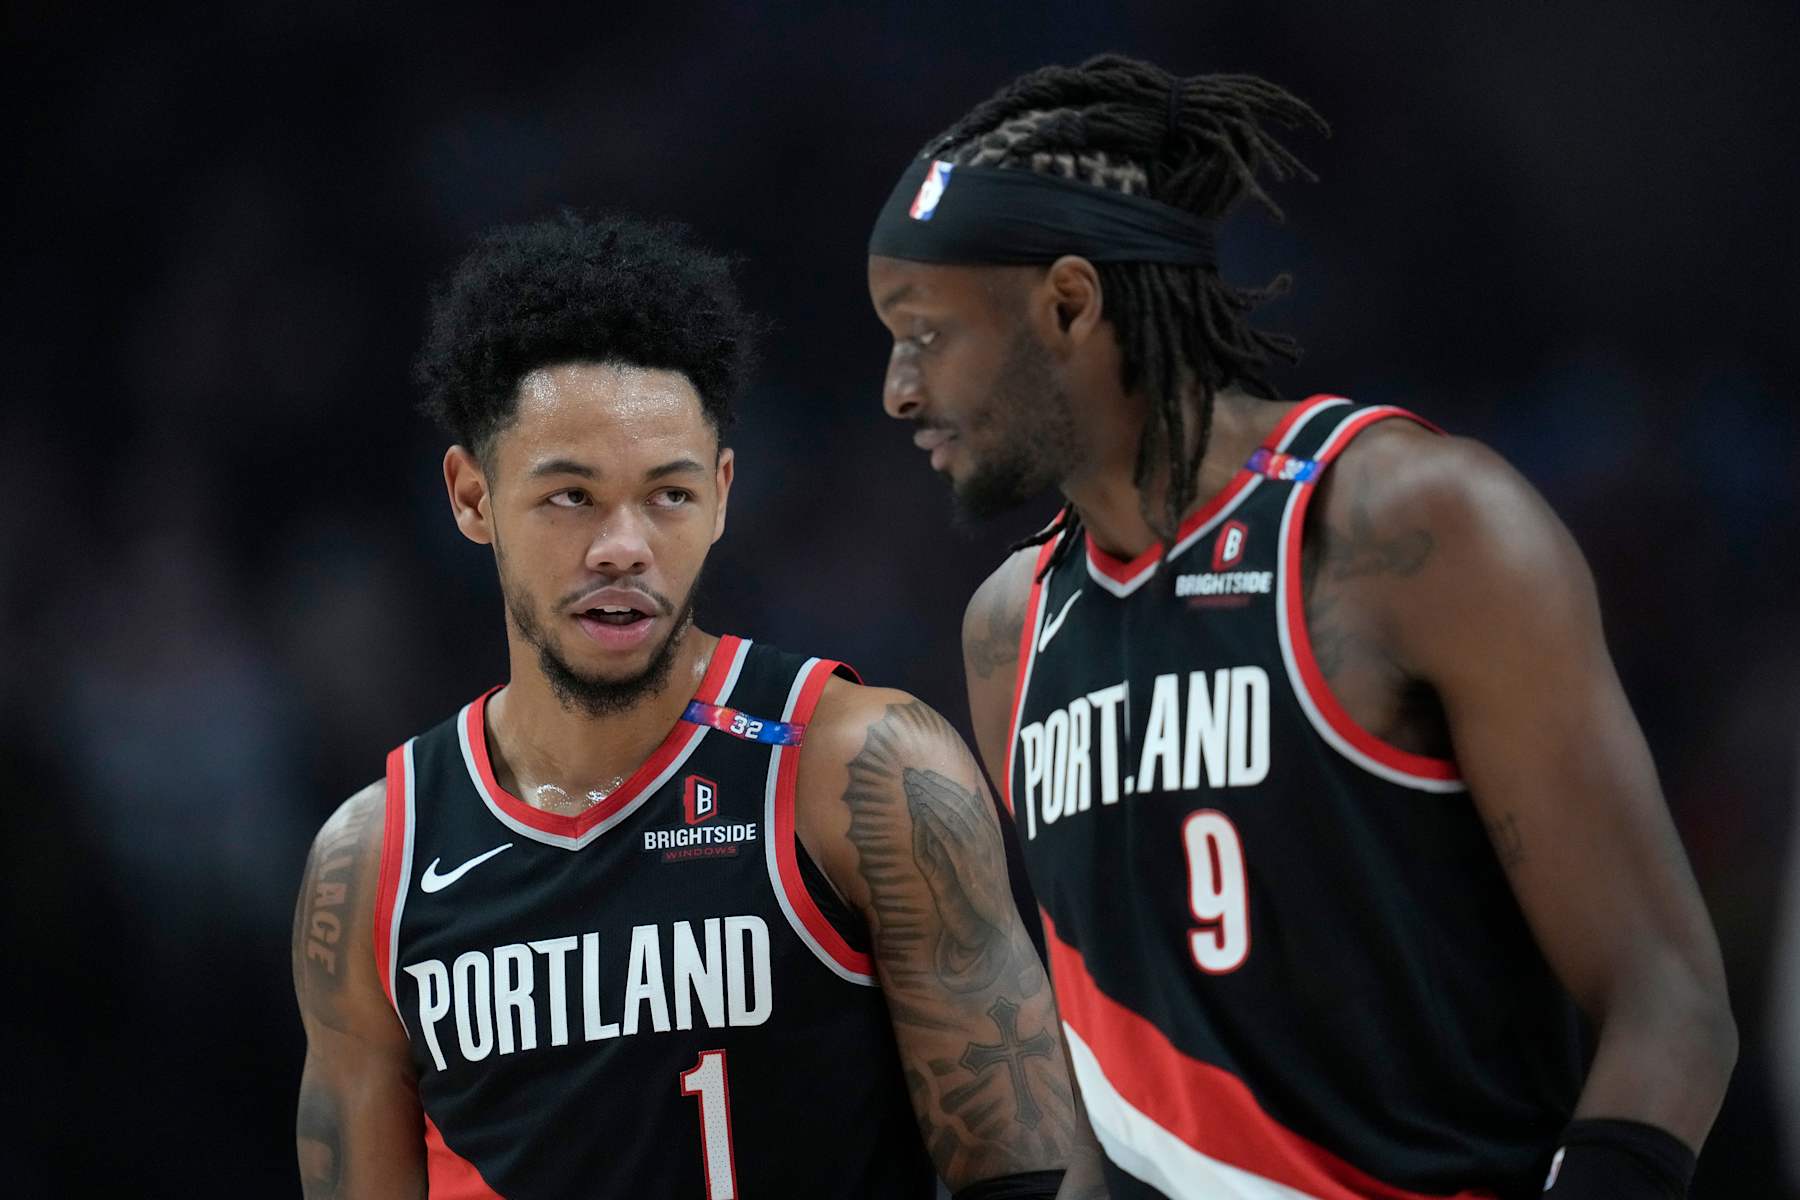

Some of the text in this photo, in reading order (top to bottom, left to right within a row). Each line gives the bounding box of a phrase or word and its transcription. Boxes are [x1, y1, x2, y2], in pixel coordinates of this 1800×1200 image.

[1223, 527, 1243, 562] B
[1175, 571, 1273, 597] BRIGHTSIDE
[729, 714, 764, 739] 32
[697, 783, 712, 815] B
[644, 822, 757, 850] BRIGHTSIDE
[665, 844, 737, 860] WINDOWS
[1180, 807, 1252, 976] 9
[403, 915, 773, 1072] PORTLAND
[680, 1048, 739, 1200] 1
